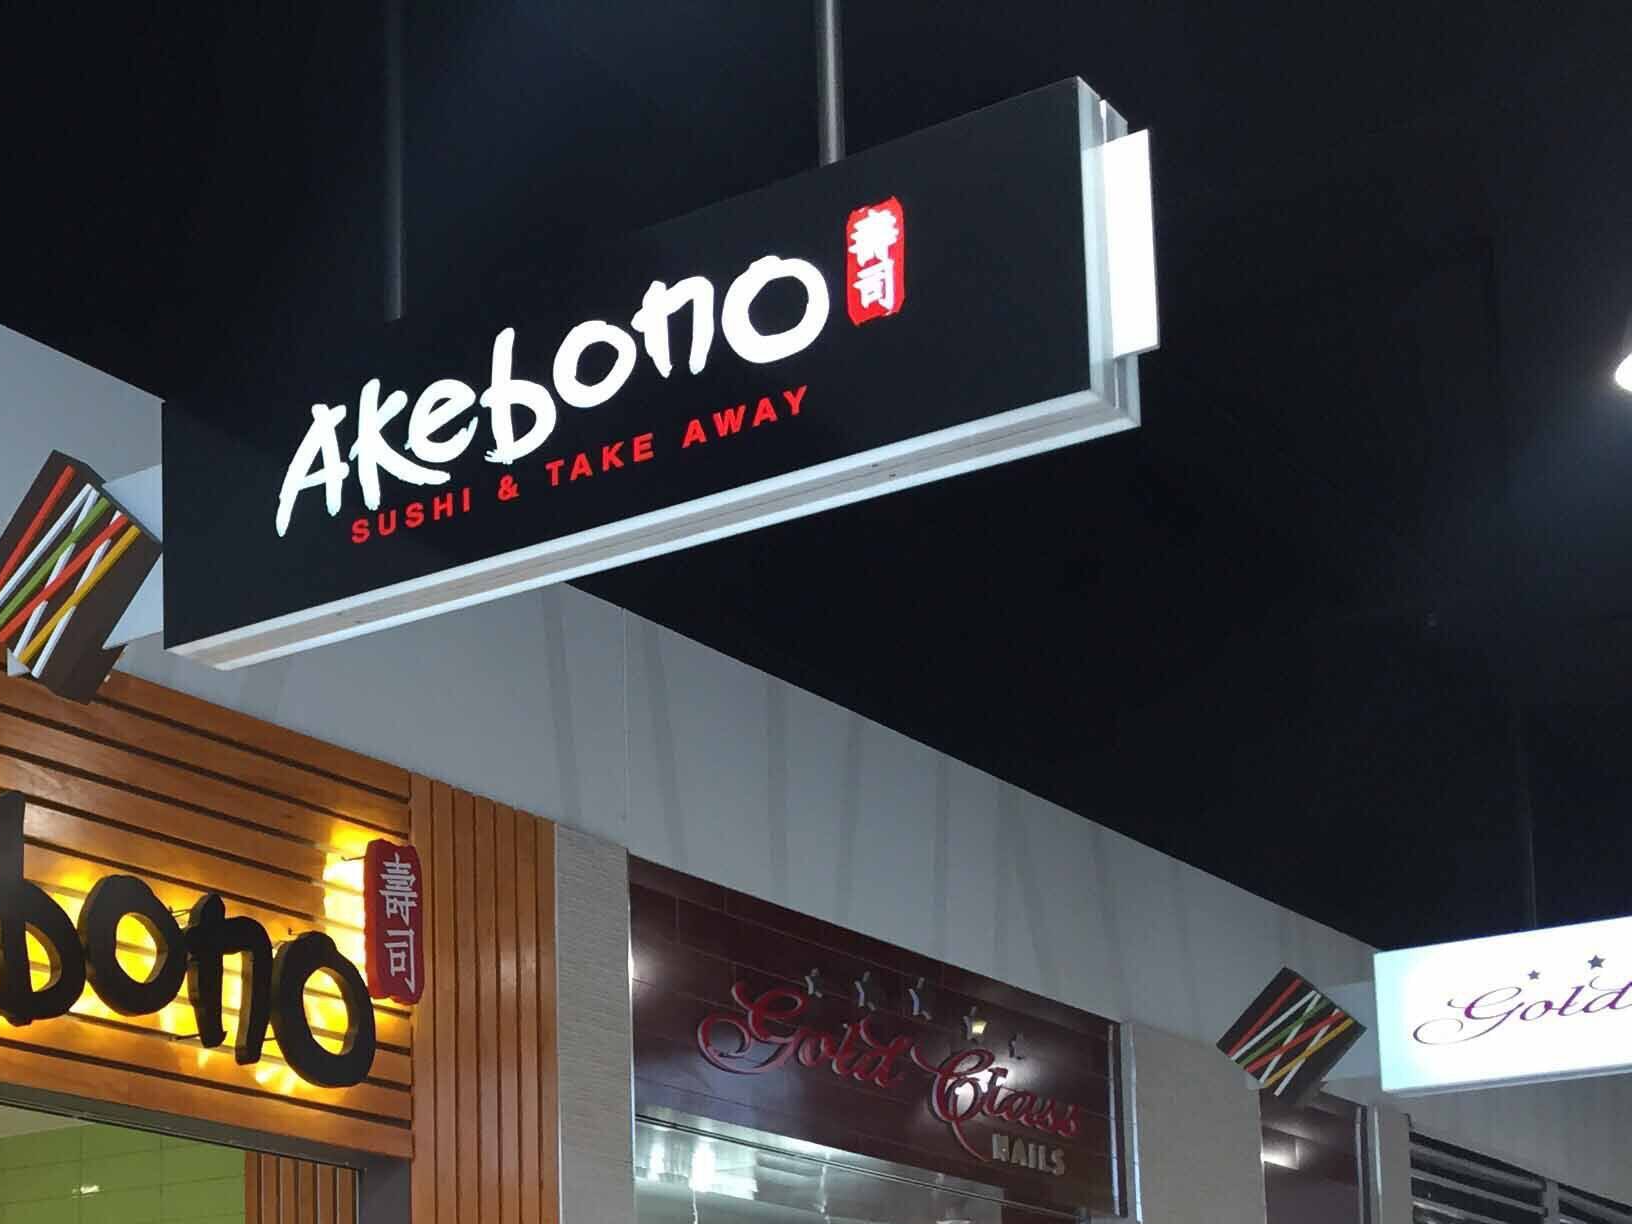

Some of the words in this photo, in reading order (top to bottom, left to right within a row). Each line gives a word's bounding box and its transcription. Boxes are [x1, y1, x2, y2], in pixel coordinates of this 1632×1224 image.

[351, 487, 472, 544] SUSHI
[497, 474, 520, 502] &
[545, 433, 655, 487] TAKE
[681, 385, 808, 448] AWAY
[1412, 976, 1632, 1046] Gold
[696, 980, 914, 1089] Gold
[909, 1047, 1080, 1162] Class
[991, 1132, 1066, 1176] NAILS
